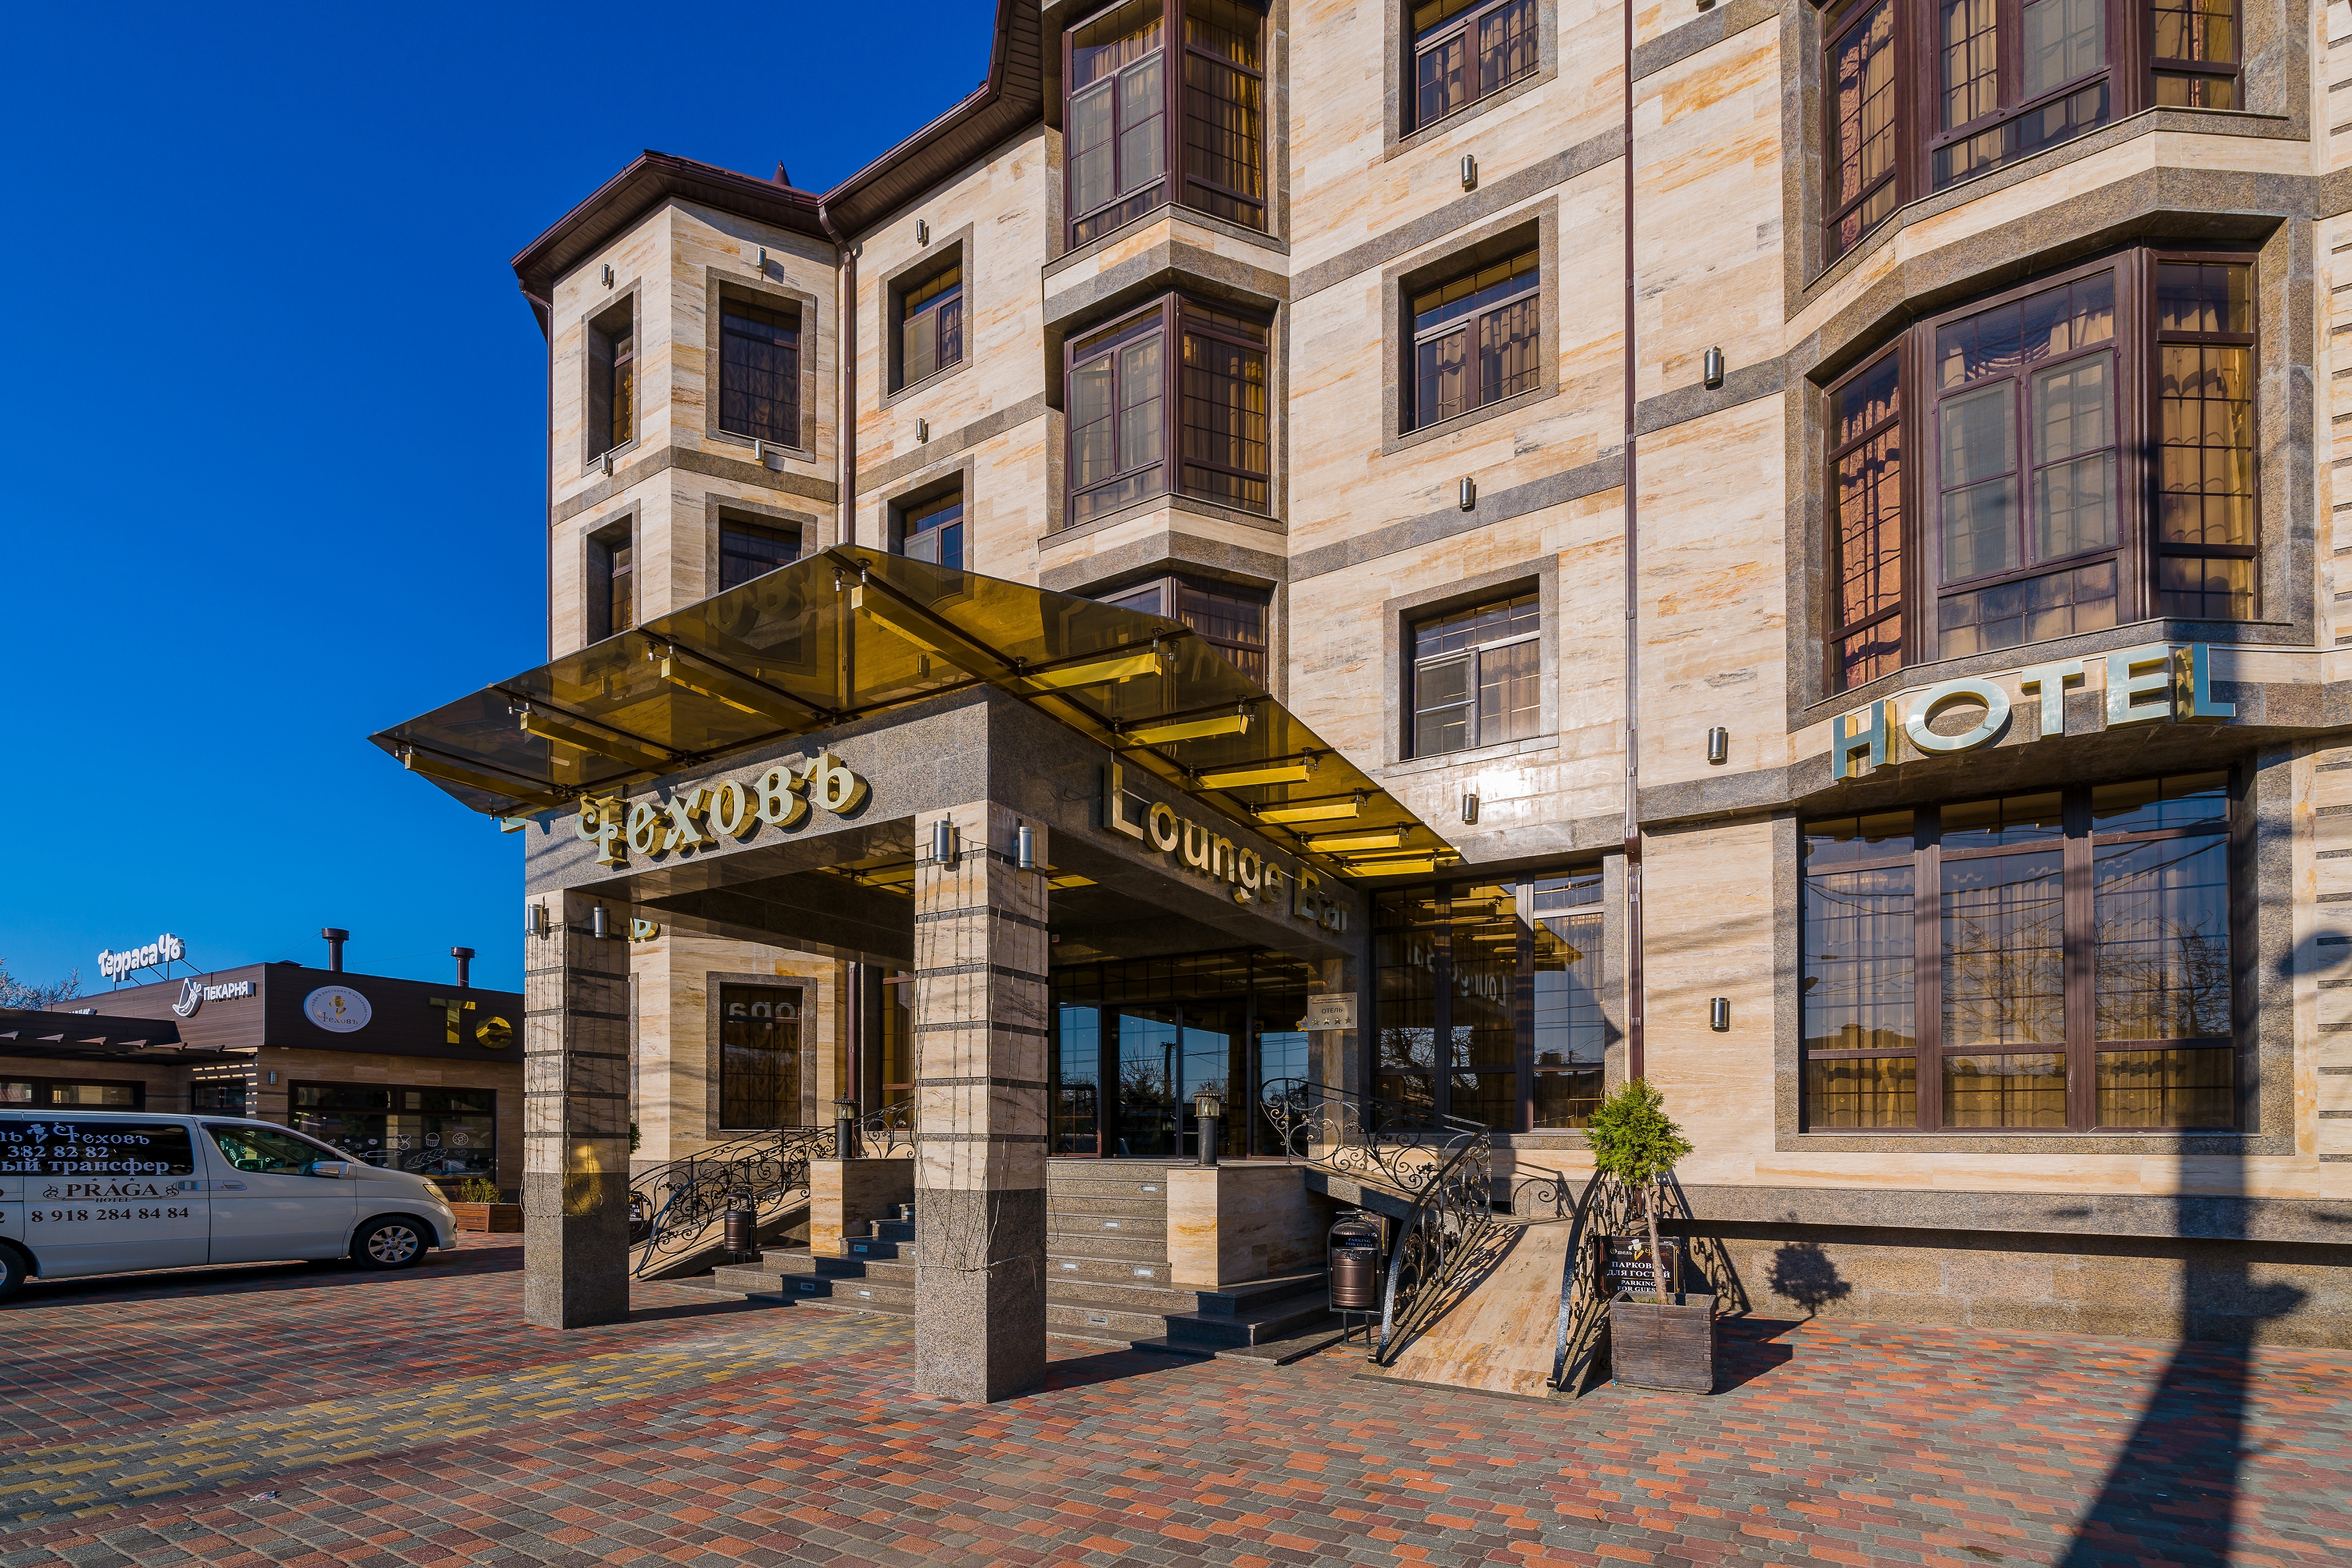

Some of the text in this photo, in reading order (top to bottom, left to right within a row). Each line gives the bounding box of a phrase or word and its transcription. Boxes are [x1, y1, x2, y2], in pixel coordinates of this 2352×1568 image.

[1832, 643, 2236, 782] HOTEL
[575, 752, 862, 866] Чеховъ
[1104, 762, 1349, 934] Lounge Bar
[98, 949, 158, 982] Терраса
[204, 981, 248, 1001] ПЕКАРНЯ
[352, 994, 367, 1013] кальянная
[317, 1009, 358, 1025] Чеховъ
[53, 1122, 150, 1145] Чеховъ
[8, 1146, 109, 1158] 382 82 82
[48, 1158, 169, 1175] трансфер
[65, 1183, 160, 1197] PRAGA
[31, 1207, 189, 1223] 8 918 284 84 84
